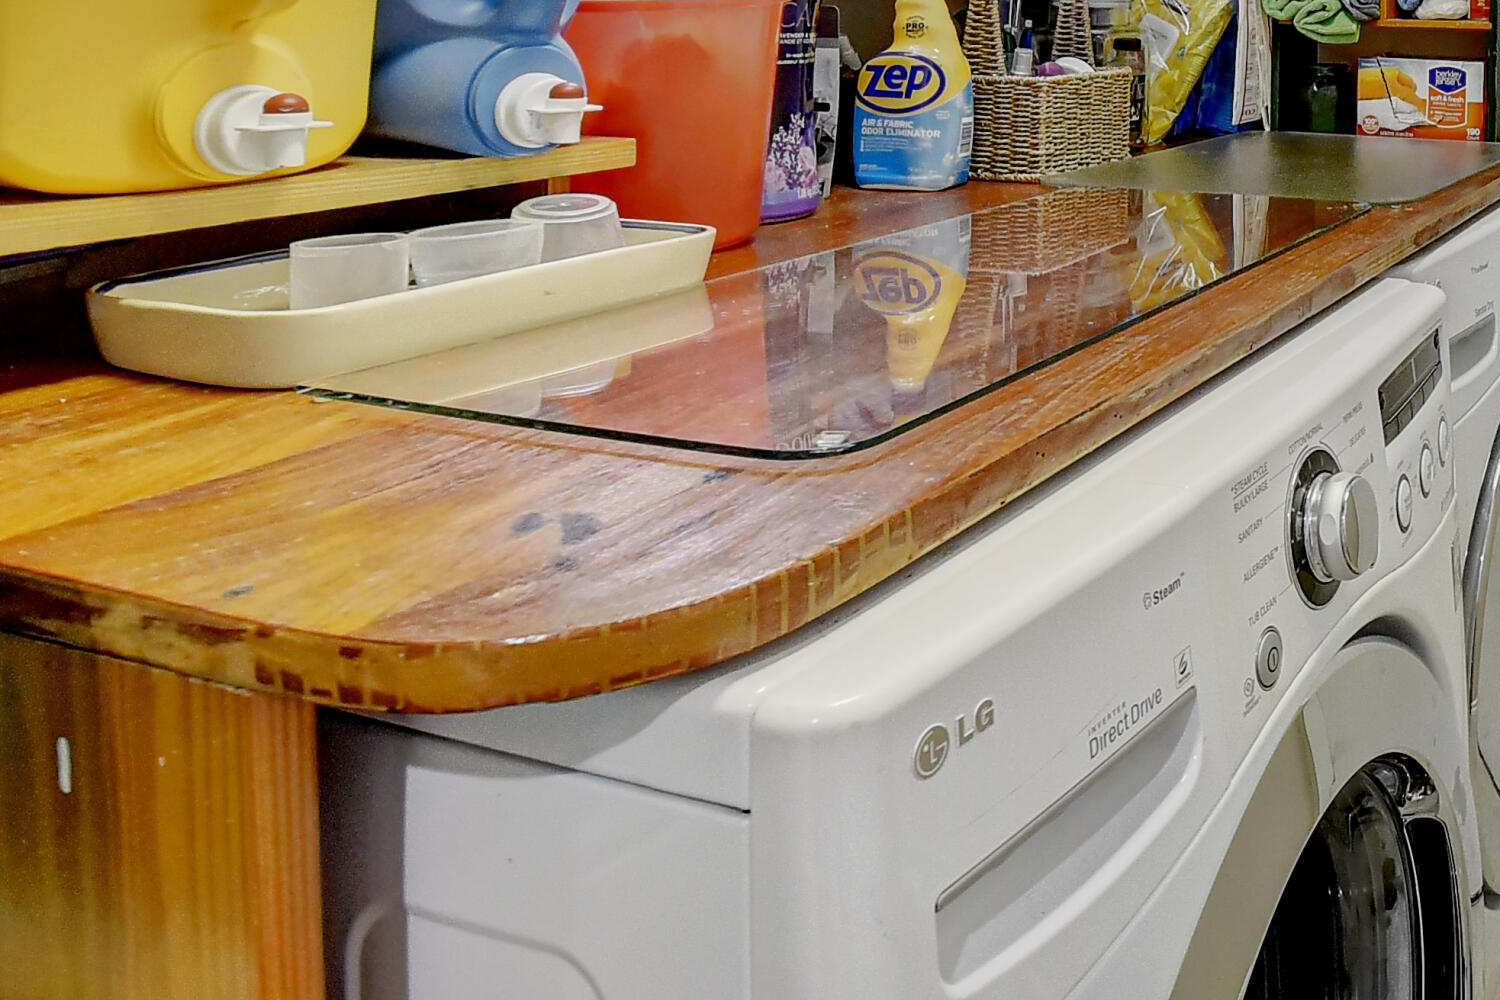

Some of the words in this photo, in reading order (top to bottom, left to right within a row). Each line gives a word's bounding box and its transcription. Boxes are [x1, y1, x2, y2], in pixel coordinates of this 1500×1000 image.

[861, 126, 884, 136] ODOR
[886, 127, 942, 138] ELIMINATOR
[884, 120, 914, 128] FABRIC
[955, 697, 995, 748] LG
[1087, 701, 1127, 736] INVERTER
[1089, 712, 1130, 760] Direct
[1130, 687, 1163, 725] Drive
